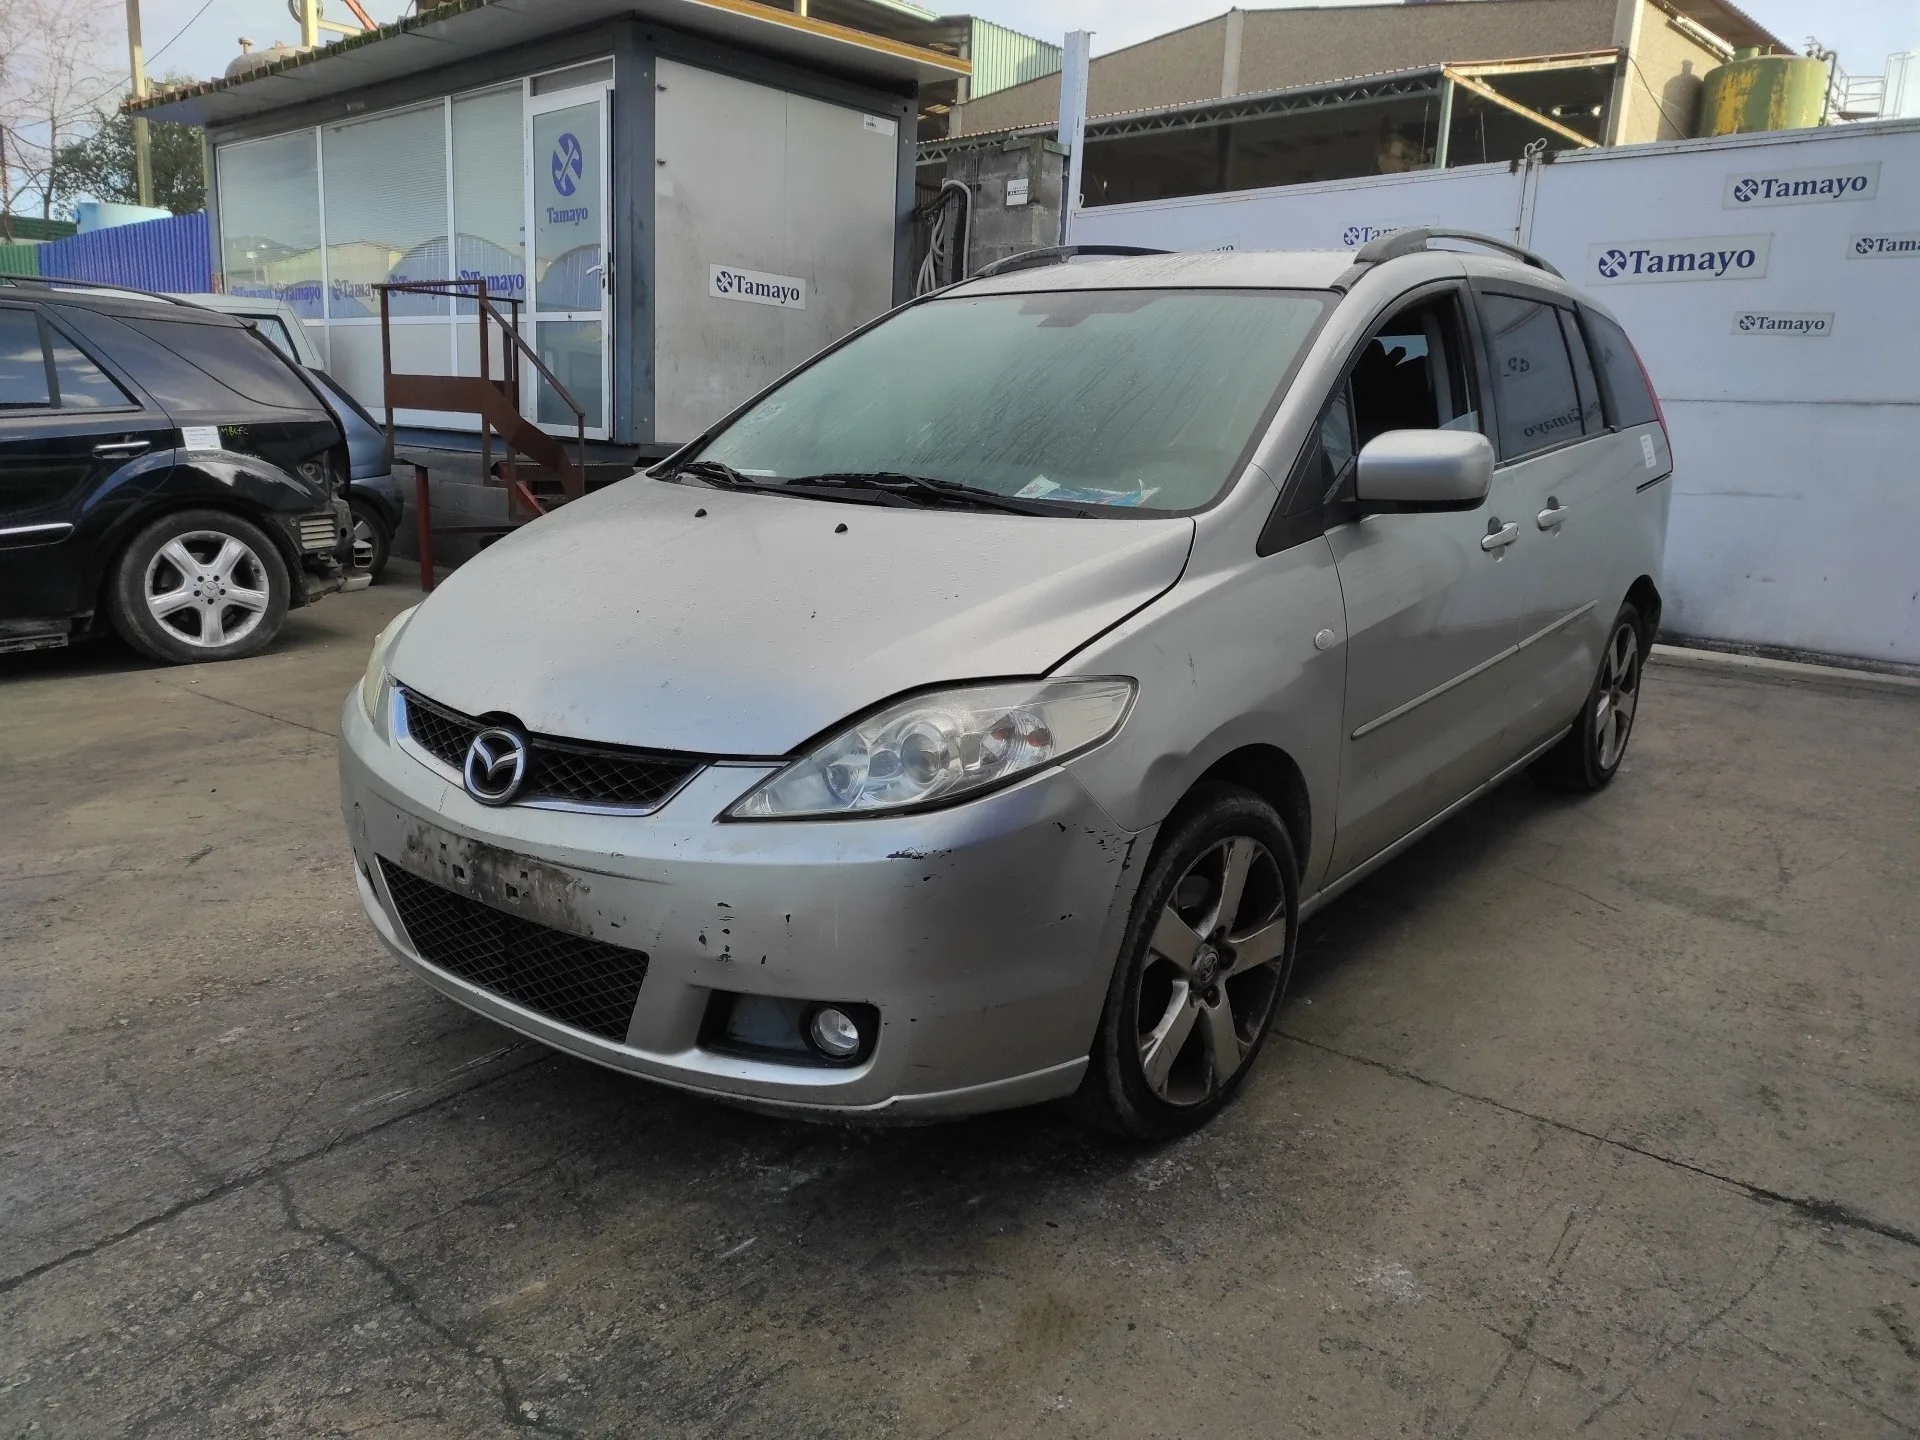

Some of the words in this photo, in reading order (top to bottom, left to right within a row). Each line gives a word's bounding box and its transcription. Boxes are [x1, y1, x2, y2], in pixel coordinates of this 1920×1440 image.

[1760, 175, 1868, 199] Tamayo
[546, 206, 589, 226] Tamayo
[1629, 249, 1756, 277] Tamayo
[470, 270, 525, 297] Tmayo
[734, 274, 800, 305] Tamayo
[1756, 316, 1825, 333] Tamayo
